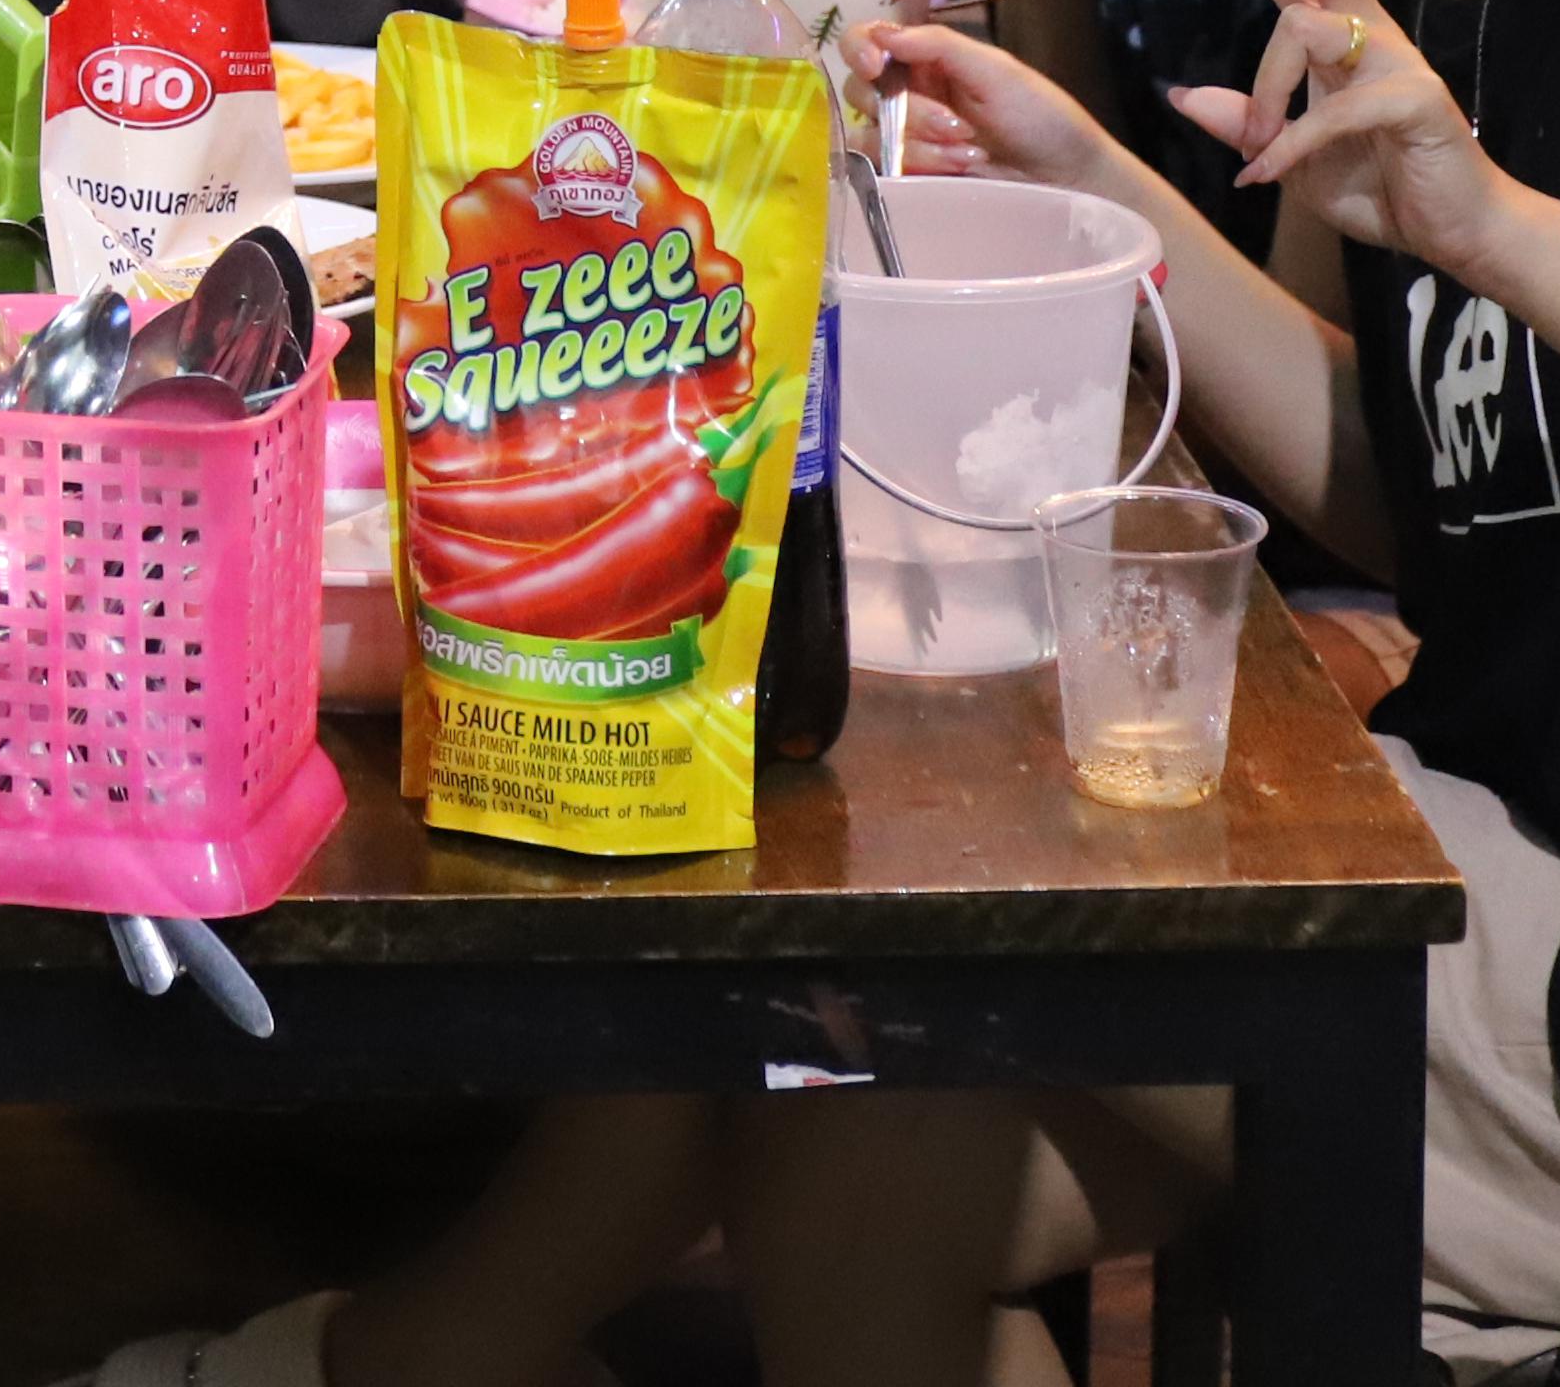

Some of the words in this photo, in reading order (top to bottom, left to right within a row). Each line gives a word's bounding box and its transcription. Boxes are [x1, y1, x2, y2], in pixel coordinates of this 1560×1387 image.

[92, 59, 195, 111] aro
[538, 121, 579, 175] GOLDEN
[581, 116, 633, 175] MOUNTAIN
[445, 265, 494, 354] E
[520, 228, 697, 337] zeee
[403, 284, 744, 433] Squeeeze
[457, 701, 526, 737] SAUCE
[533, 714, 597, 745] MILD
[605, 721, 651, 748] HOT
[480, 734, 521, 755] PIMENT
[455, 748, 476, 769] VAN
[478, 754, 490, 772] DE
[494, 757, 521, 776] SAUS
[523, 763, 546, 780] VAN
[548, 766, 563, 783] DE
[566, 767, 618, 787] SPAANSE
[621, 769, 656, 788] PEPER
[492, 778, 521, 800] 900
[524, 783, 555, 806] กรัม
[561, 801, 610, 819] Product
[618, 805, 632, 819] of
[640, 802, 687, 819] Thailand
